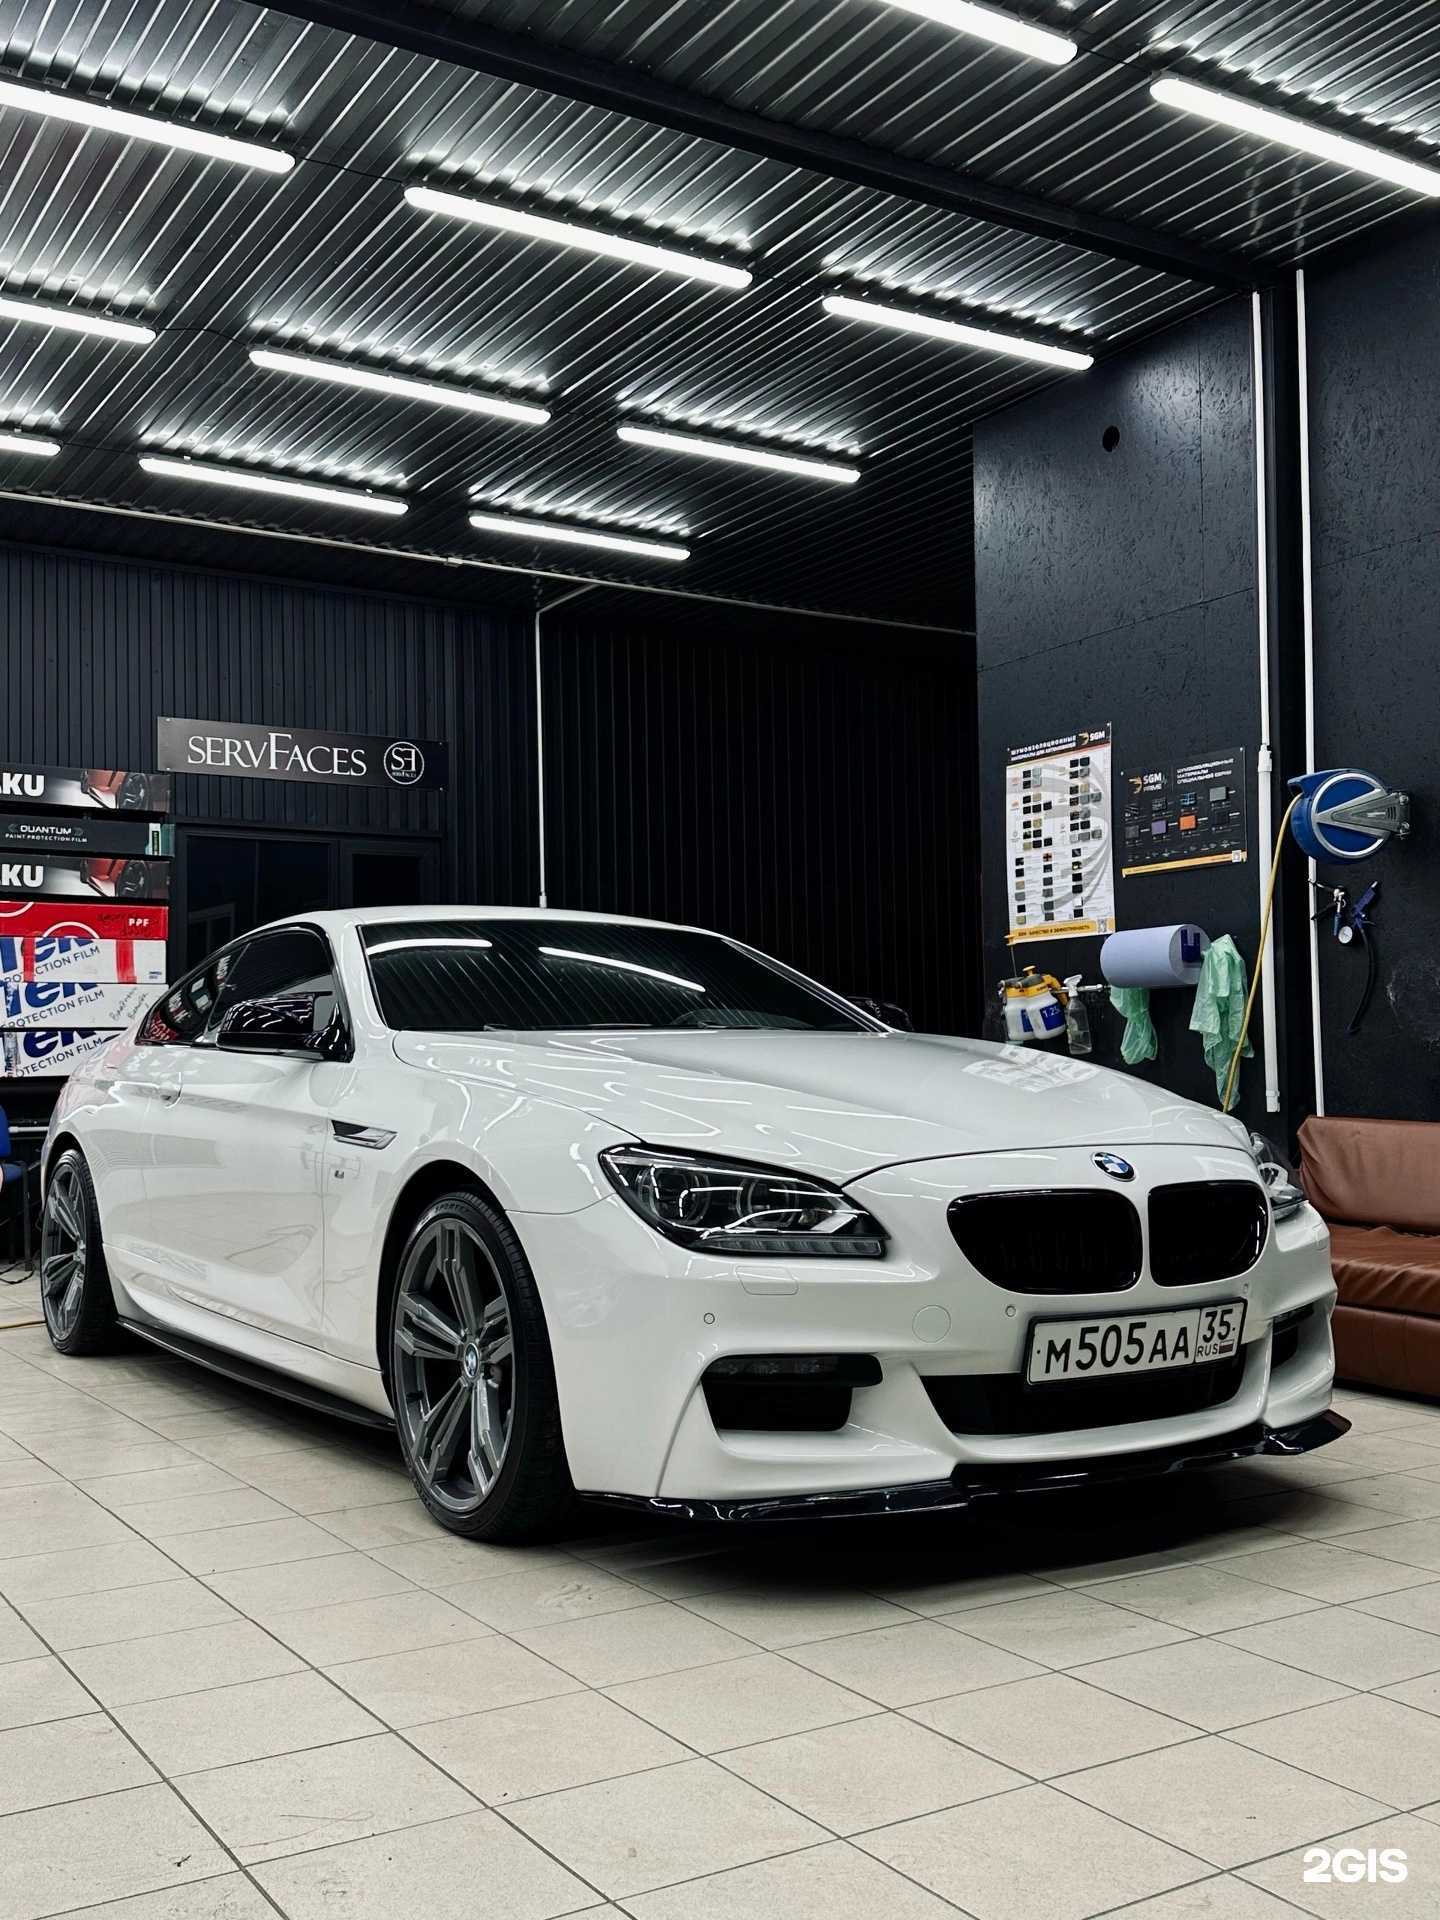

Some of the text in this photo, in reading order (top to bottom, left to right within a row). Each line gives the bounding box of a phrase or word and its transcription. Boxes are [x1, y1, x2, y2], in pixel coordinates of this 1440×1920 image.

[1089, 730, 1105, 742] SGM
[0, 773, 45, 797] KU
[1143, 772, 1162, 785] SGM
[20, 825, 72, 835] QUANTUM
[27, 834, 71, 842] PROTECTION
[0, 864, 44, 888] KU
[128, 918, 150, 927] PPF
[74, 946, 101, 962] FILM
[78, 990, 105, 1005] FILM
[77, 1037, 103, 1053] FILM
[1202, 1309, 1234, 1344] 35
[1196, 1343, 1218, 1357] RUS
